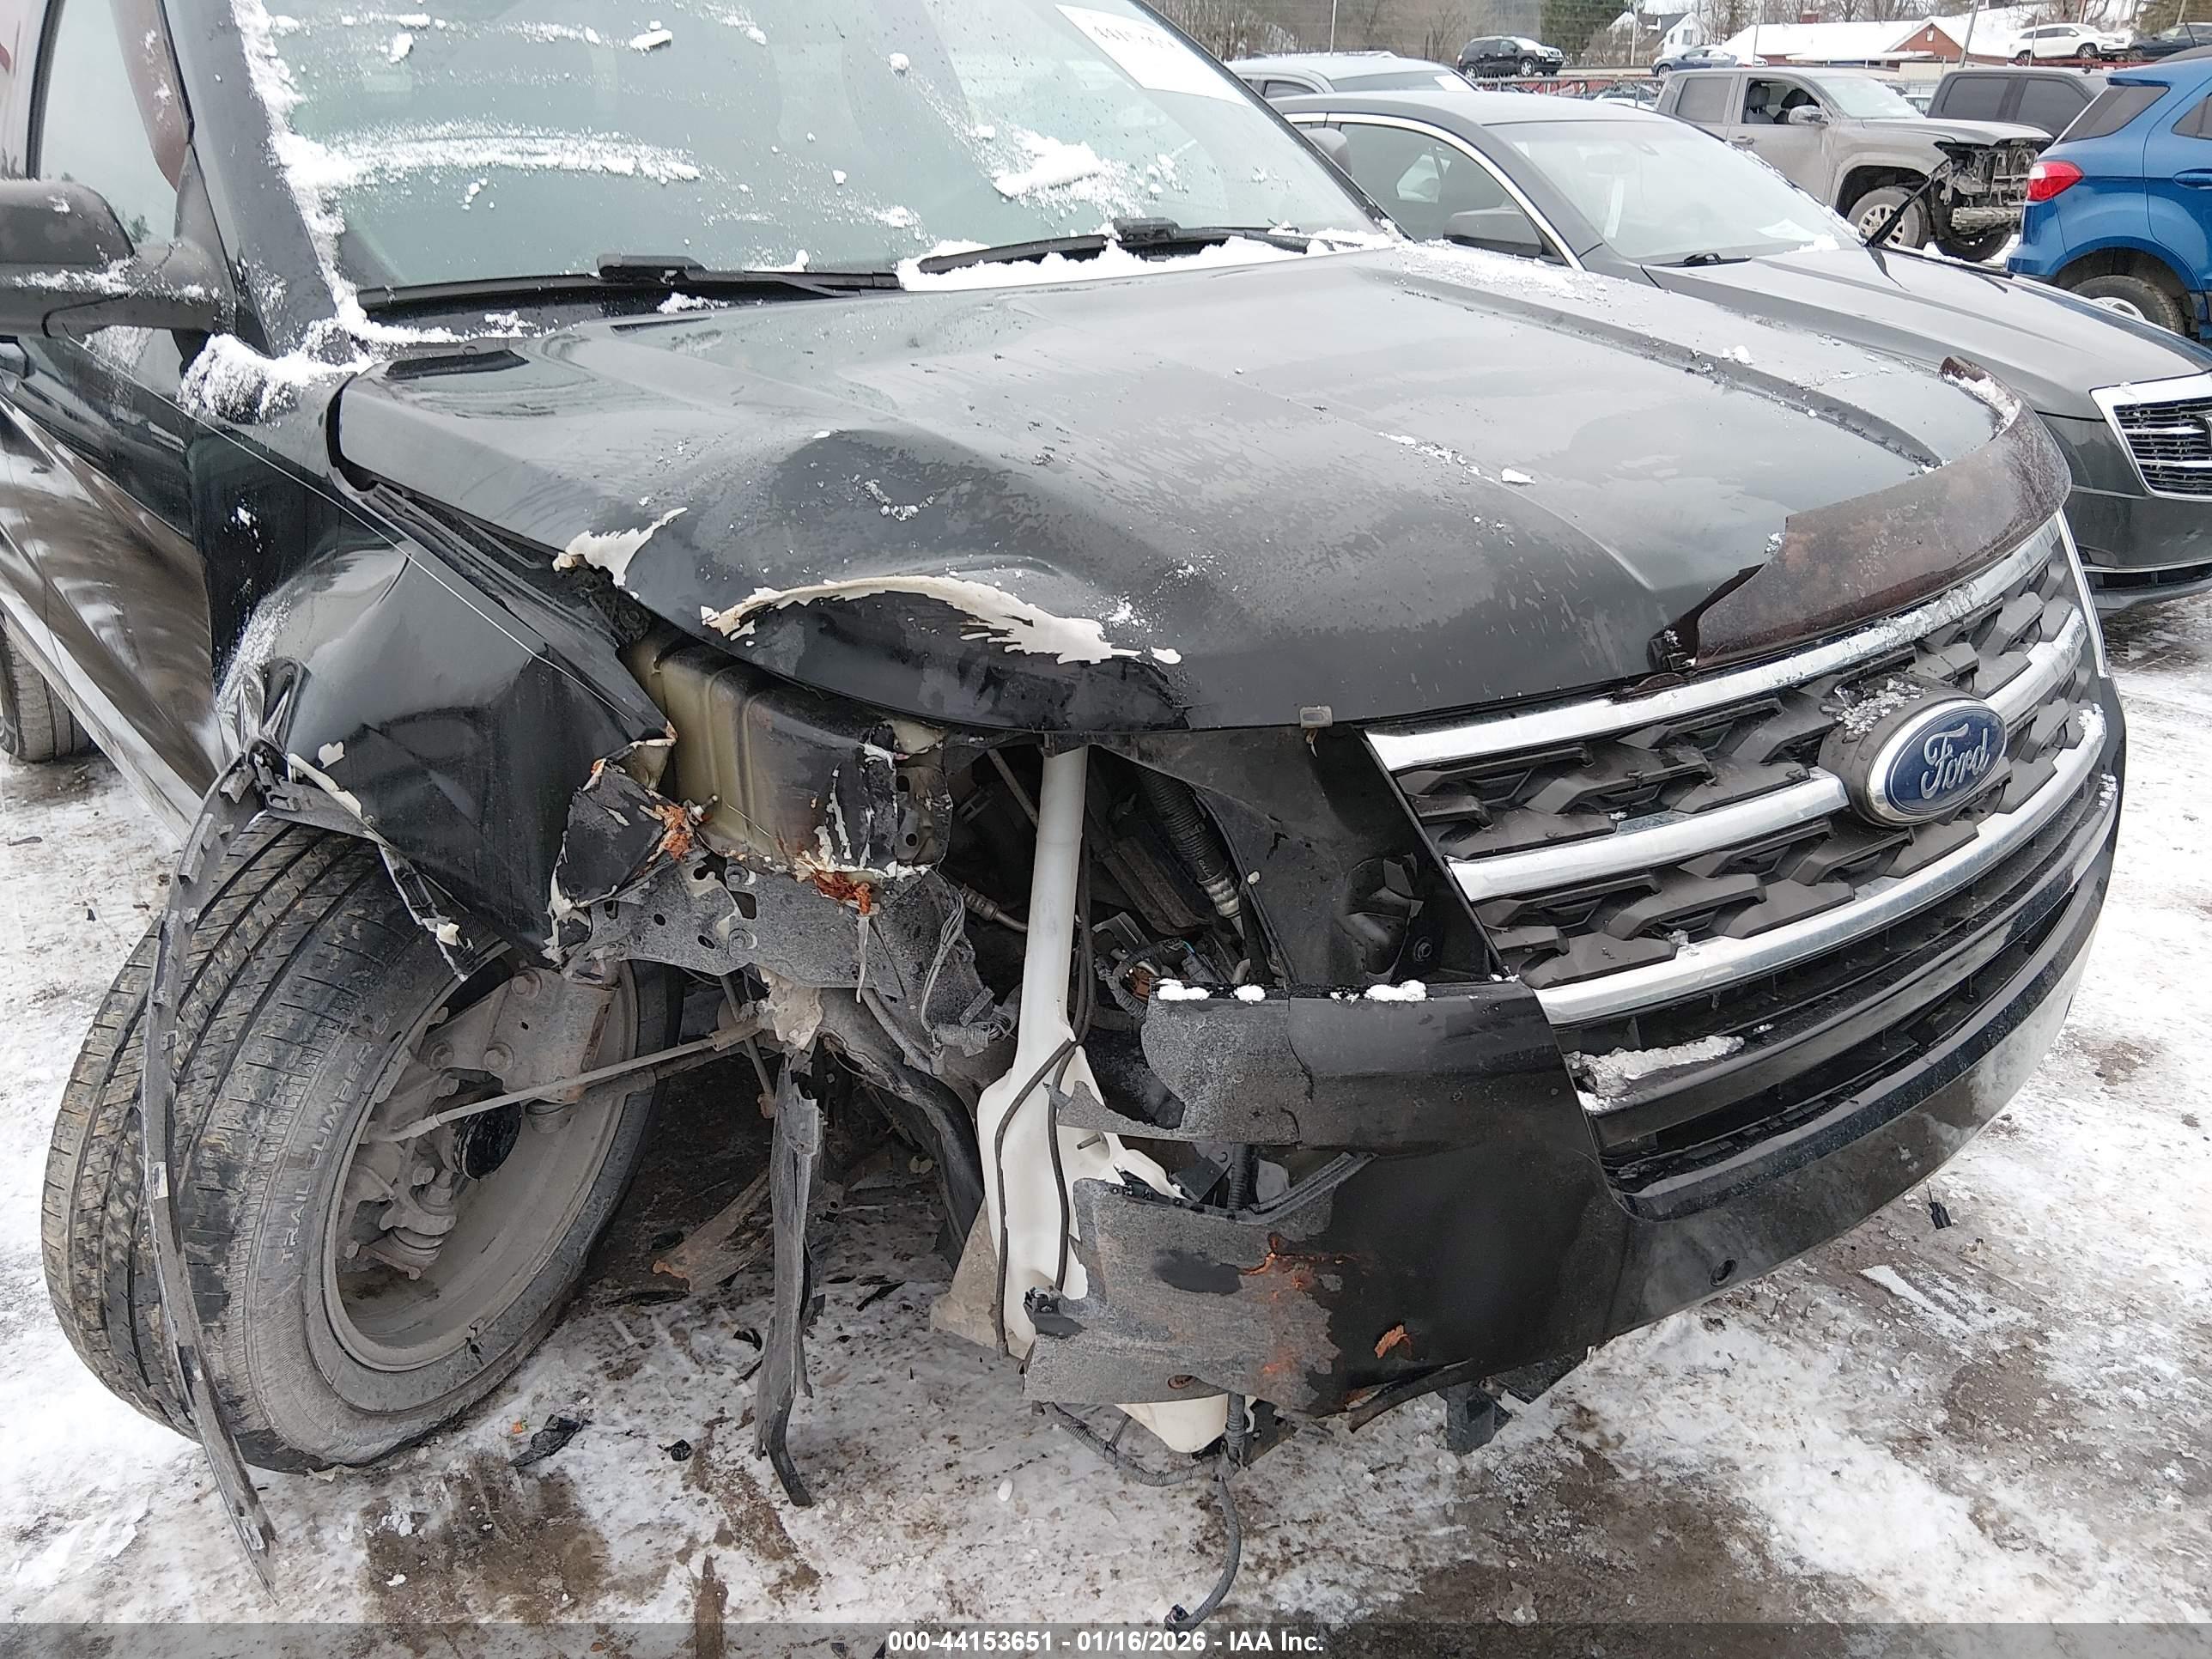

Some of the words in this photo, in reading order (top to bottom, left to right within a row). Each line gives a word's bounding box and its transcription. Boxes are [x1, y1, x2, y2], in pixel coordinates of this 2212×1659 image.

[1920, 723, 1990, 799] Ford
[280, 1186, 311, 1265] TRAIL
[310, 1041, 374, 1169] CLIMBER
